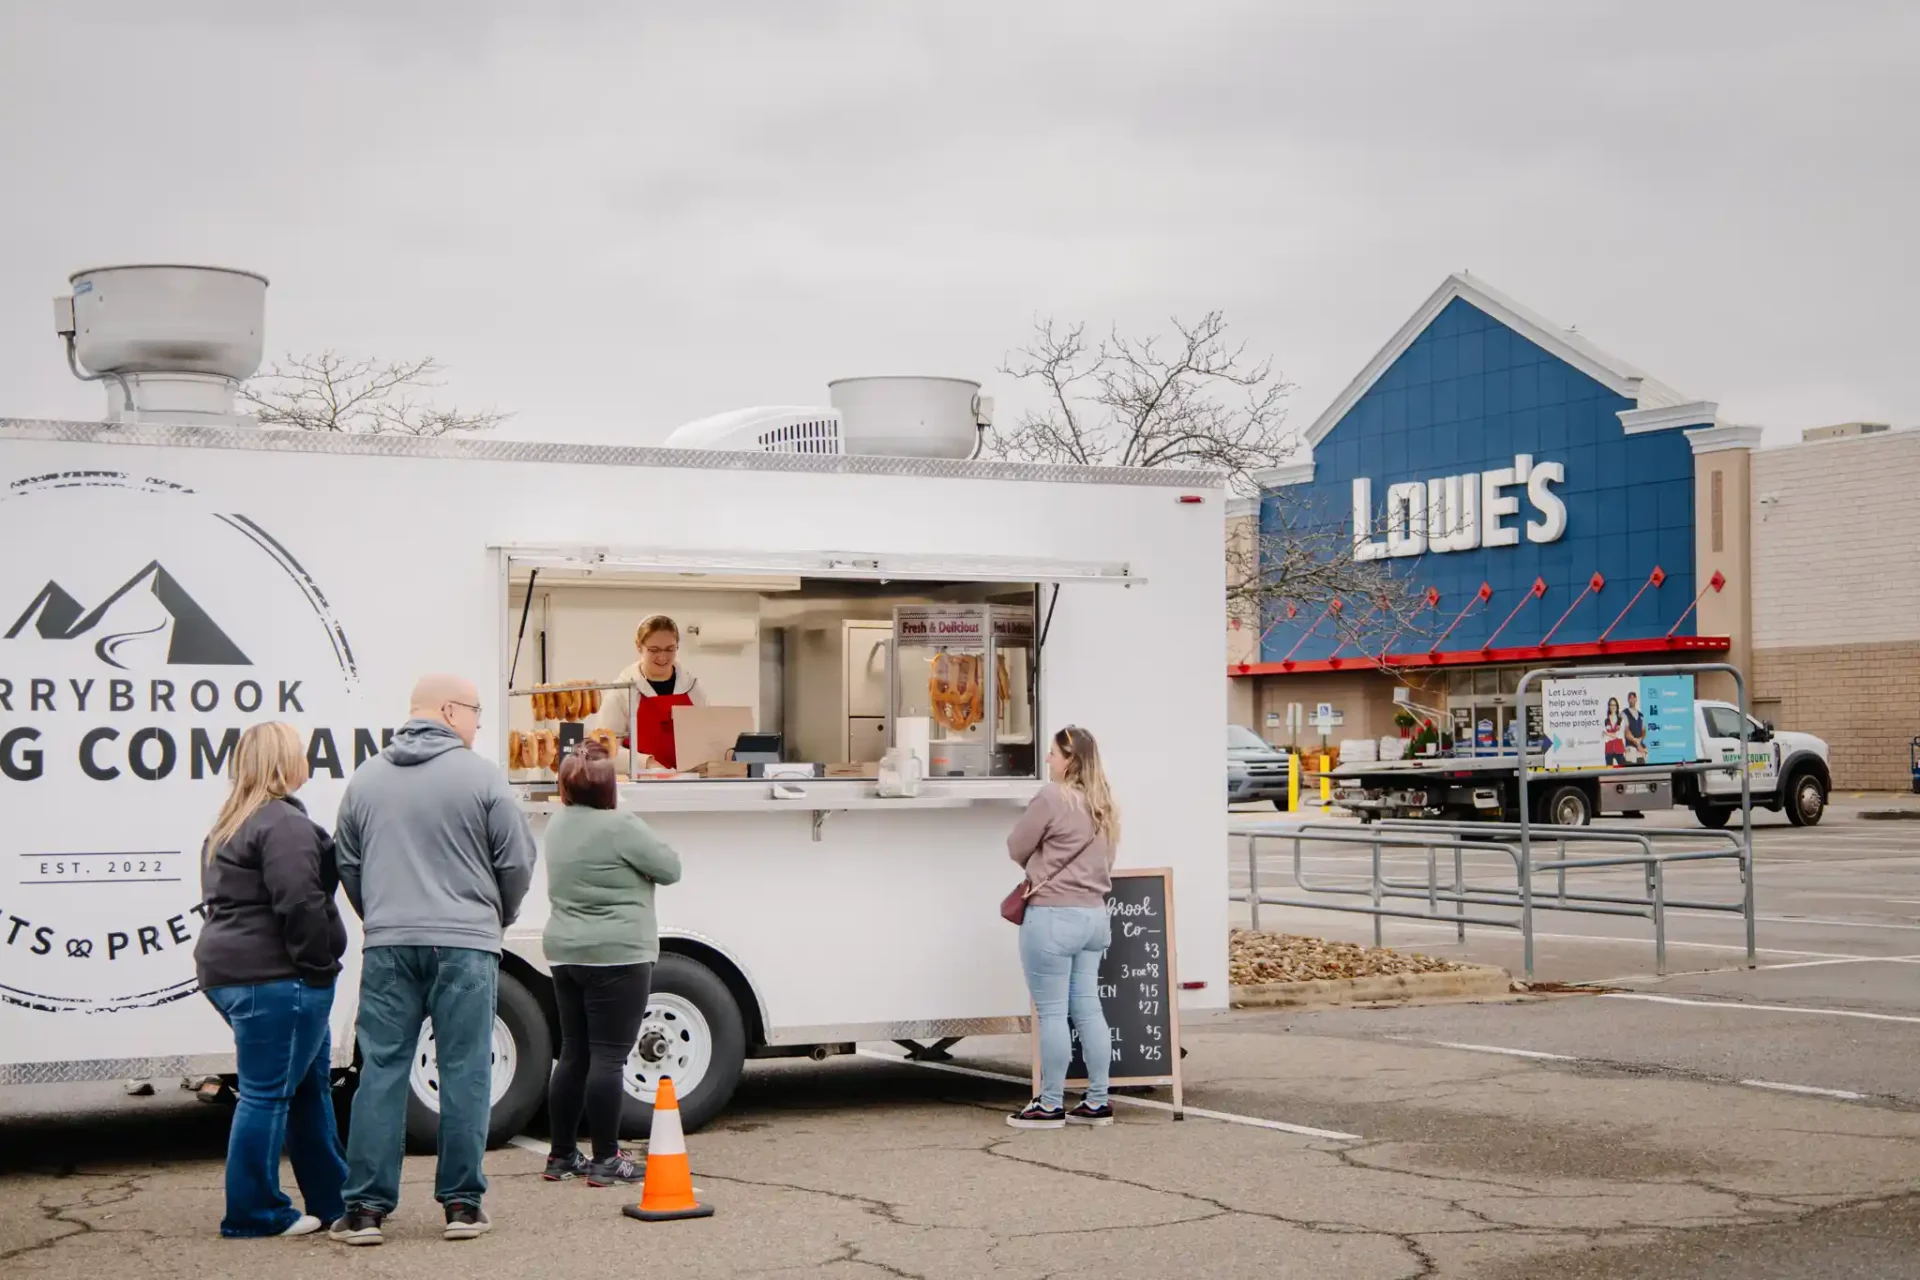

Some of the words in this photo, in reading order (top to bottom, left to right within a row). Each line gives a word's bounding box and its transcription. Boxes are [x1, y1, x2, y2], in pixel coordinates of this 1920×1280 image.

[1353, 454, 1567, 561] LOWE'S
[903, 622, 926, 633] Fresh
[929, 623, 936, 633] &
[938, 621, 979, 633] Delicious
[1548, 688, 1560, 697] Let
[1562, 687, 1587, 696] Lowe's
[1549, 699, 1565, 708] help
[1561, 710, 1577, 718] your
[1550, 720, 1571, 728] home
[79, 726, 394, 781] COMAN
[40, 862, 90, 874] EST.
[108, 861, 162, 873] 2022
[1107, 896, 1157, 916] brook
[0, 908, 55, 955] TS
[1144, 942, 1160, 958] $3
[1121, 964, 1129, 979] 3
[1132, 968, 1147, 977] FOR
[1146, 962, 1159, 978] $8
[1140, 983, 1159, 998] $15
[1138, 1000, 1159, 1016] $27
[1145, 1024, 1161, 1040] $5
[1140, 1044, 1161, 1060] $25
